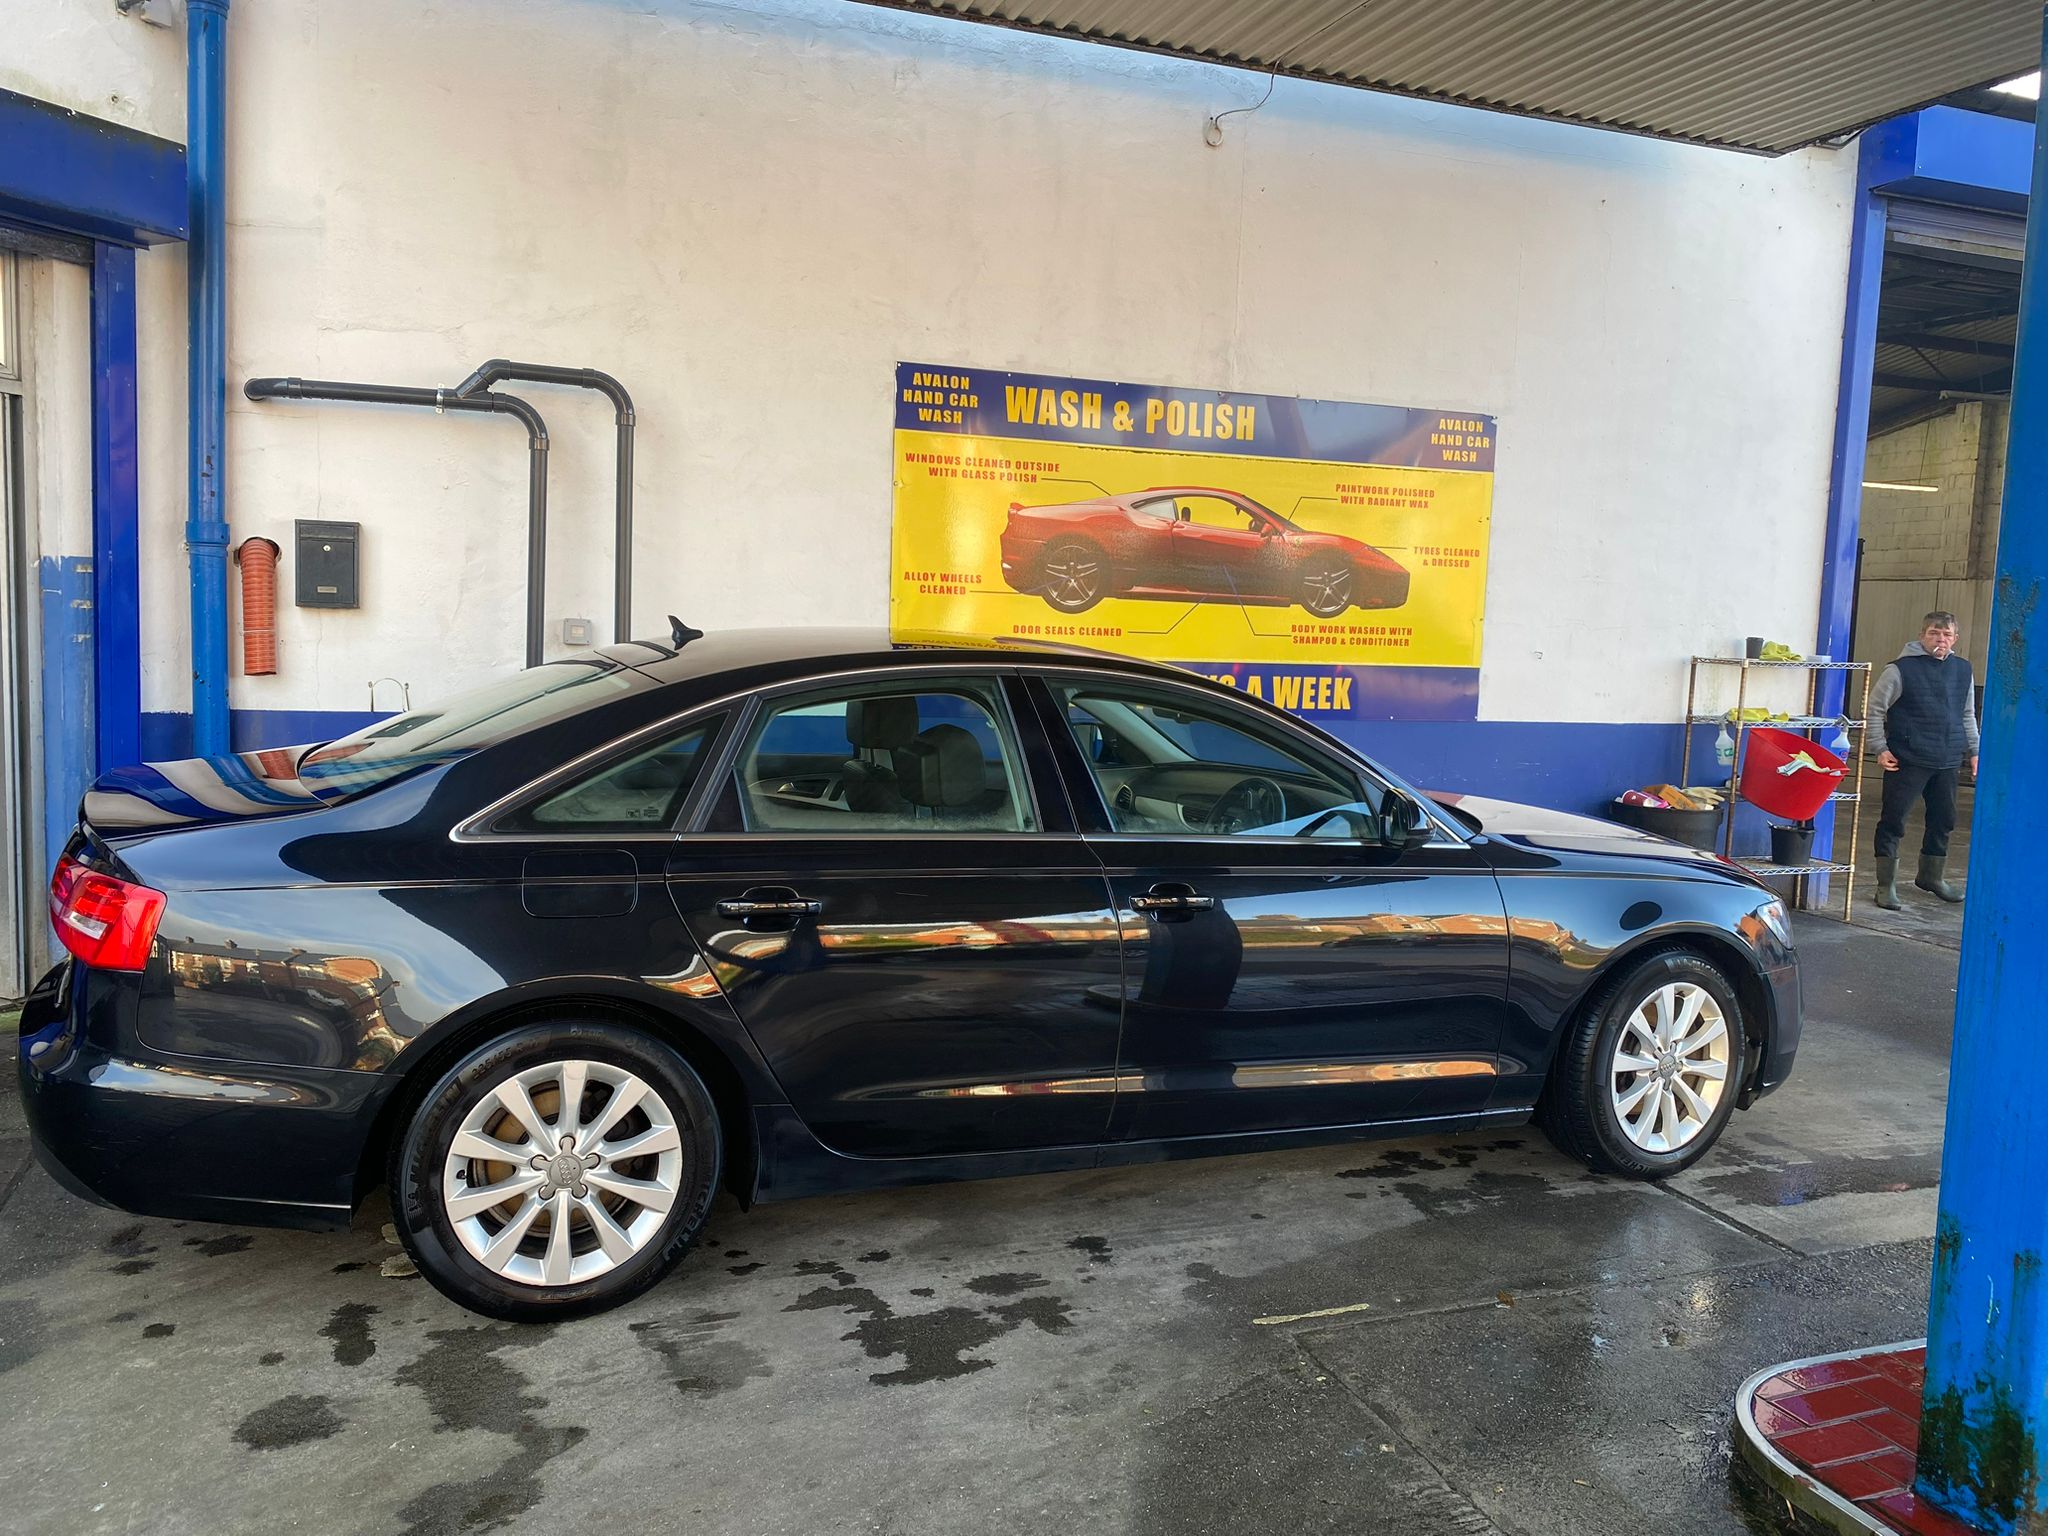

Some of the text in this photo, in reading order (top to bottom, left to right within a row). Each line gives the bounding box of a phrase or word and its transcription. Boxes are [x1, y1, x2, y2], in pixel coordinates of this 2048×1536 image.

[912, 372, 970, 390] AVALON
[903, 389, 978, 409] HAND CAR
[918, 408, 963, 424] WASH
[1005, 385, 1255, 441] WASH & POLISH
[1439, 418, 1484, 433] AVALON
[1431, 433, 1490, 449] HAND CAR
[905, 452, 1060, 473] WINDOWS CLEANED OUTSIDE
[1442, 449, 1477, 463] WASH
[928, 467, 1037, 483] WITH GLASS POLISH
[1335, 483, 1435, 498] PAINTWORK POLISHED
[1340, 495, 1430, 509] WITH RADIANT WAX
[1413, 546, 1480, 558] TYRES CLEANED
[1422, 557, 1470, 568] & DRESSED
[904, 571, 982, 584] ALLOY WHEELS
[919, 584, 966, 595] CLEANED
[1012, 624, 1122, 637] DOOR SEALS CLEANED
[1291, 624, 1413, 636] BODY WORK WASHED WITH
[1292, 635, 1410, 647] SHAMPOO & CONDITIONER
[1246, 676, 1262, 698] A
[1273, 676, 1352, 710] WEEK
